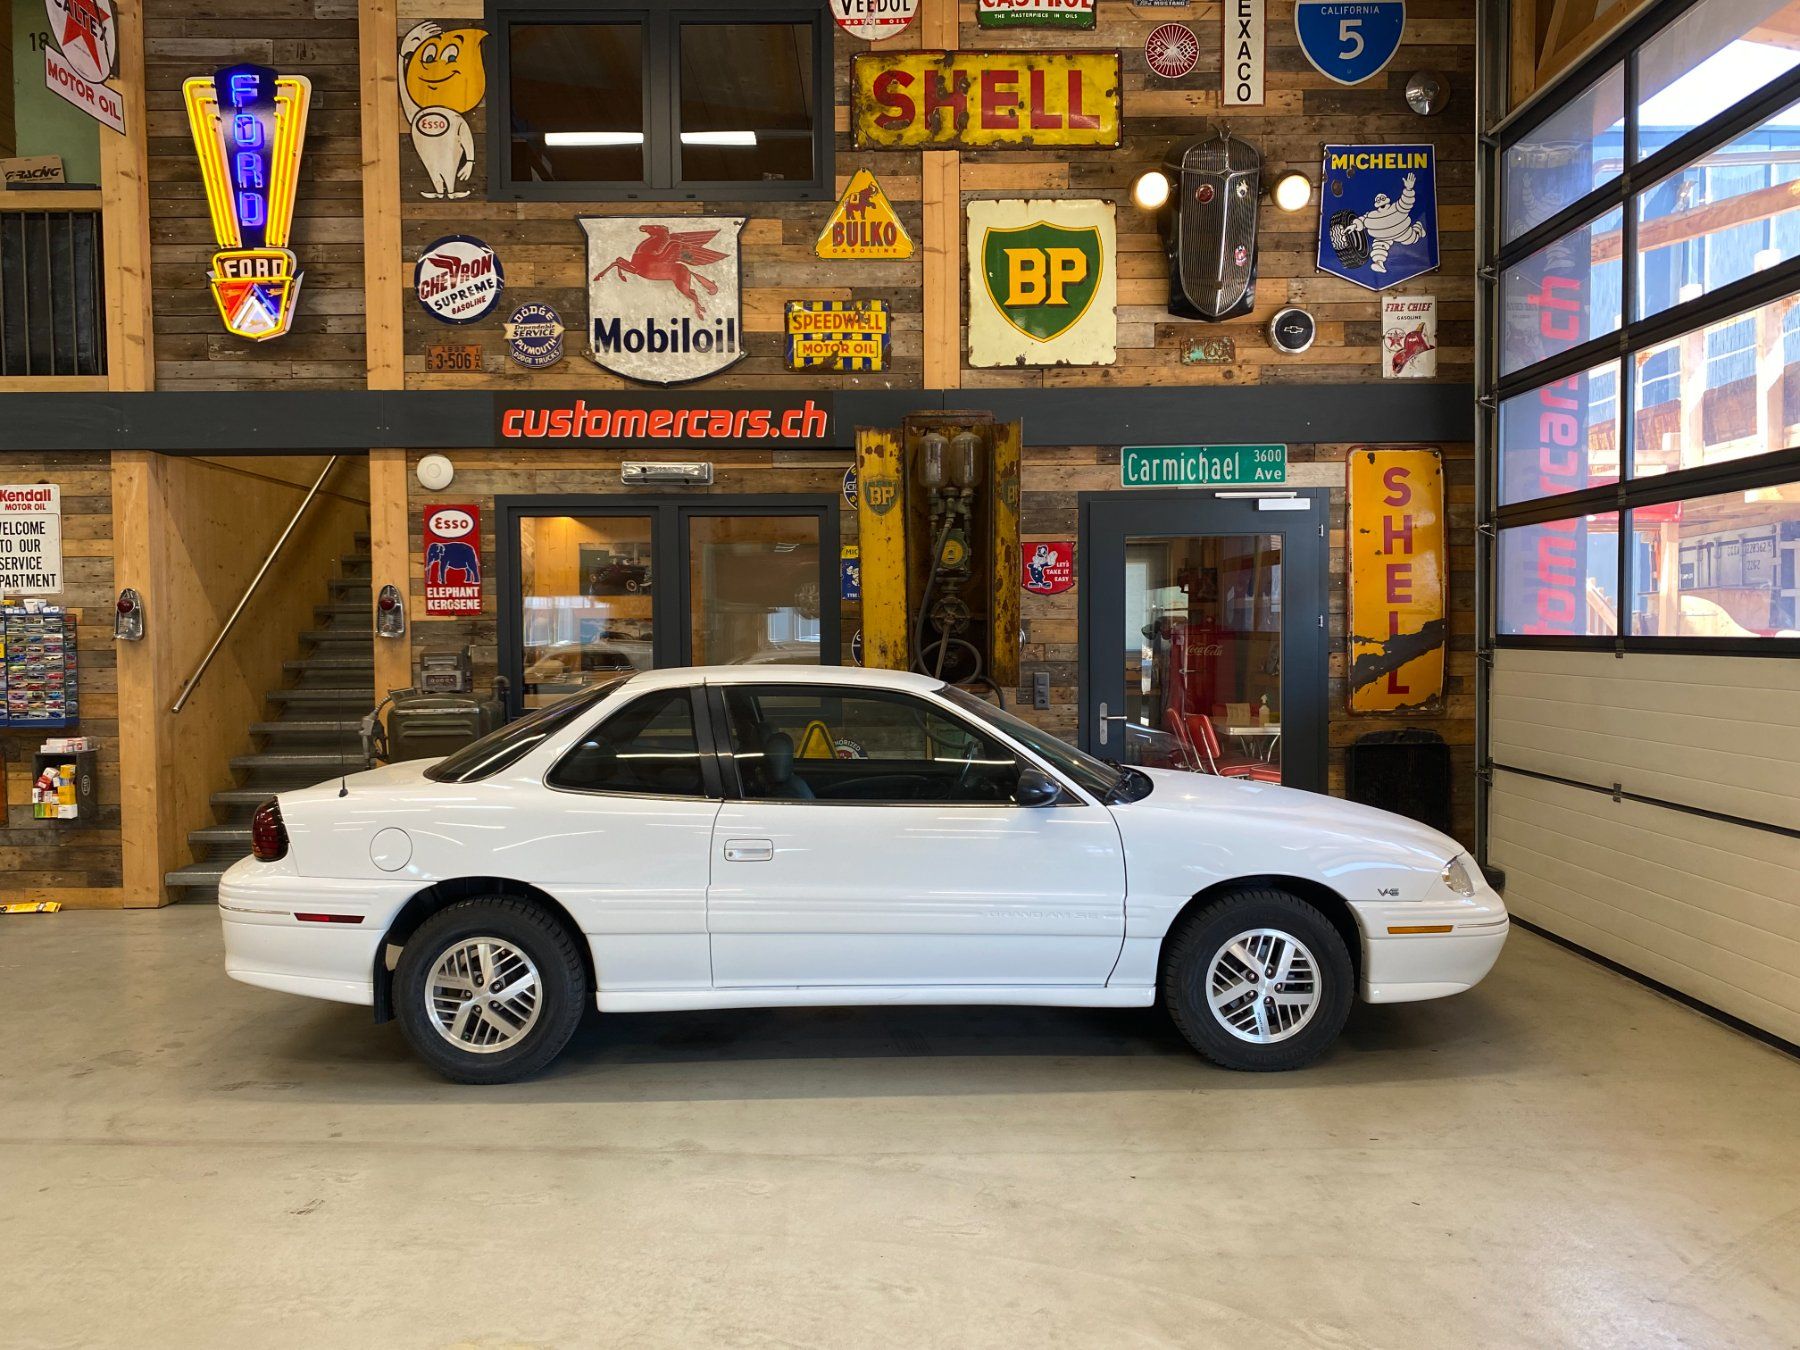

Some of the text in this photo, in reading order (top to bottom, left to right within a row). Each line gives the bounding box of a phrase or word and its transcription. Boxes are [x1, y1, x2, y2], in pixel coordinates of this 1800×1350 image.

[1320, 6, 1380, 15] CALIFORNIA
[1338, 19, 1365, 60] 5
[47, 58, 122, 121] MOTOR OIL
[873, 69, 1101, 130] SHELL
[231, 74, 265, 227] FORD
[1331, 153, 1428, 170] MICHELIN
[832, 220, 898, 247] BULKO
[223, 258, 284, 279] FORD
[420, 253, 493, 301] CHEVRON
[1003, 247, 1089, 308] BP
[434, 278, 495, 311] SUPREME
[451, 295, 487, 315] GASOLINE
[1385, 302, 1433, 312] FIRE CHIEF
[513, 305, 555, 323] DODGE
[793, 313, 883, 331] SPEEDWELL
[512, 329, 555, 338] SERVICE
[594, 317, 736, 353] Mobiloil
[514, 338, 557, 355] PLYMOUTH
[802, 341, 875, 354] MOTOR OIL
[436, 352, 471, 369] 3-506
[501, 399, 828, 438] customercars.ch
[1254, 449, 1282, 463] 3600
[1128, 452, 1239, 482] Carmichael
[1254, 467, 1282, 480] Ave
[0, 489, 51, 502] Kendall
[869, 486, 895, 506] BP
[5, 503, 46, 511] MOTOR OIL
[0, 521, 46, 535] ELCOME
[0, 539, 41, 553] TO OUR
[0, 556, 42, 571] SERVICE
[426, 587, 480, 598] ELEPHANT
[427, 599, 481, 610] KEROSENE
